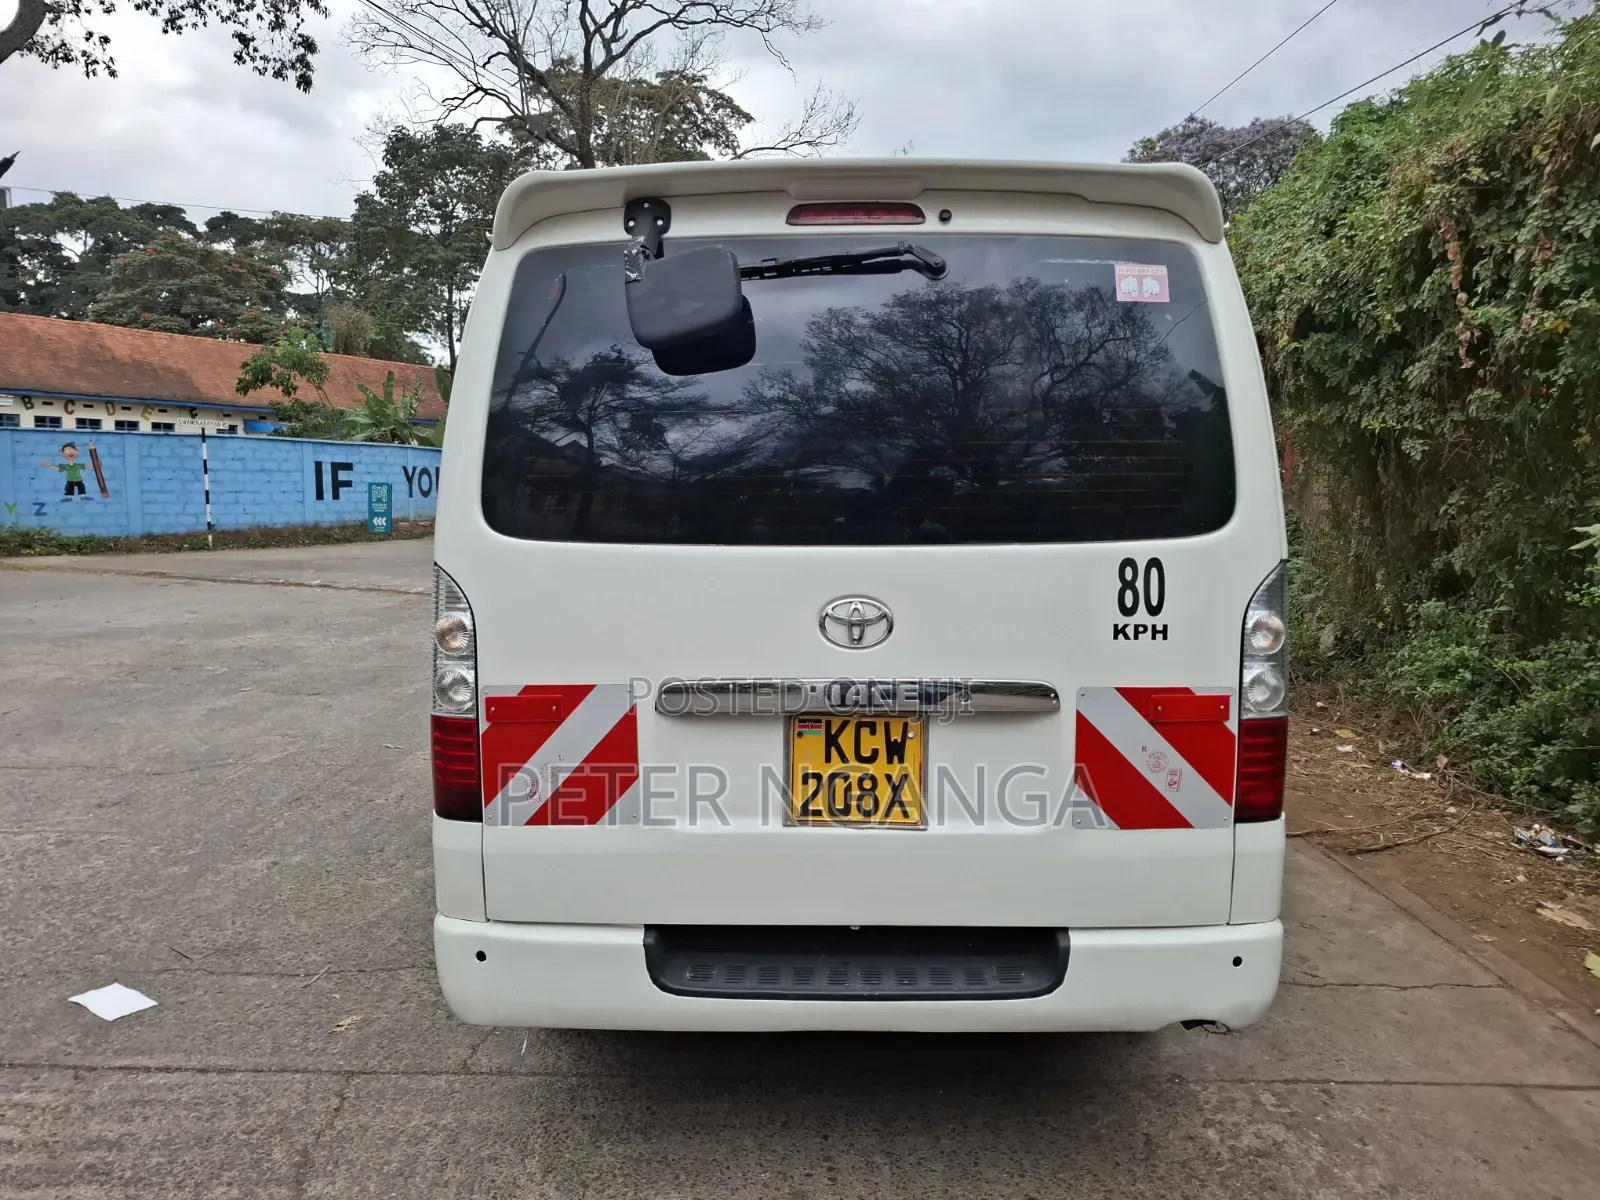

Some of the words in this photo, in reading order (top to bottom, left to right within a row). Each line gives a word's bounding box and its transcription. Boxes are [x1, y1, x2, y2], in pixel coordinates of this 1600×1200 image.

[21, 396, 34, 411] B
[63, 399, 76, 415] C
[105, 401, 116, 416] D
[140, 403, 155, 422] E
[314, 460, 354, 500] IF
[4, 501, 18, 515] Y
[32, 502, 47, 516] Z
[1117, 557, 1165, 617] 80
[1113, 623, 1168, 640] KPH
[824, 719, 909, 765] KCW
[800, 771, 910, 818] 208X
